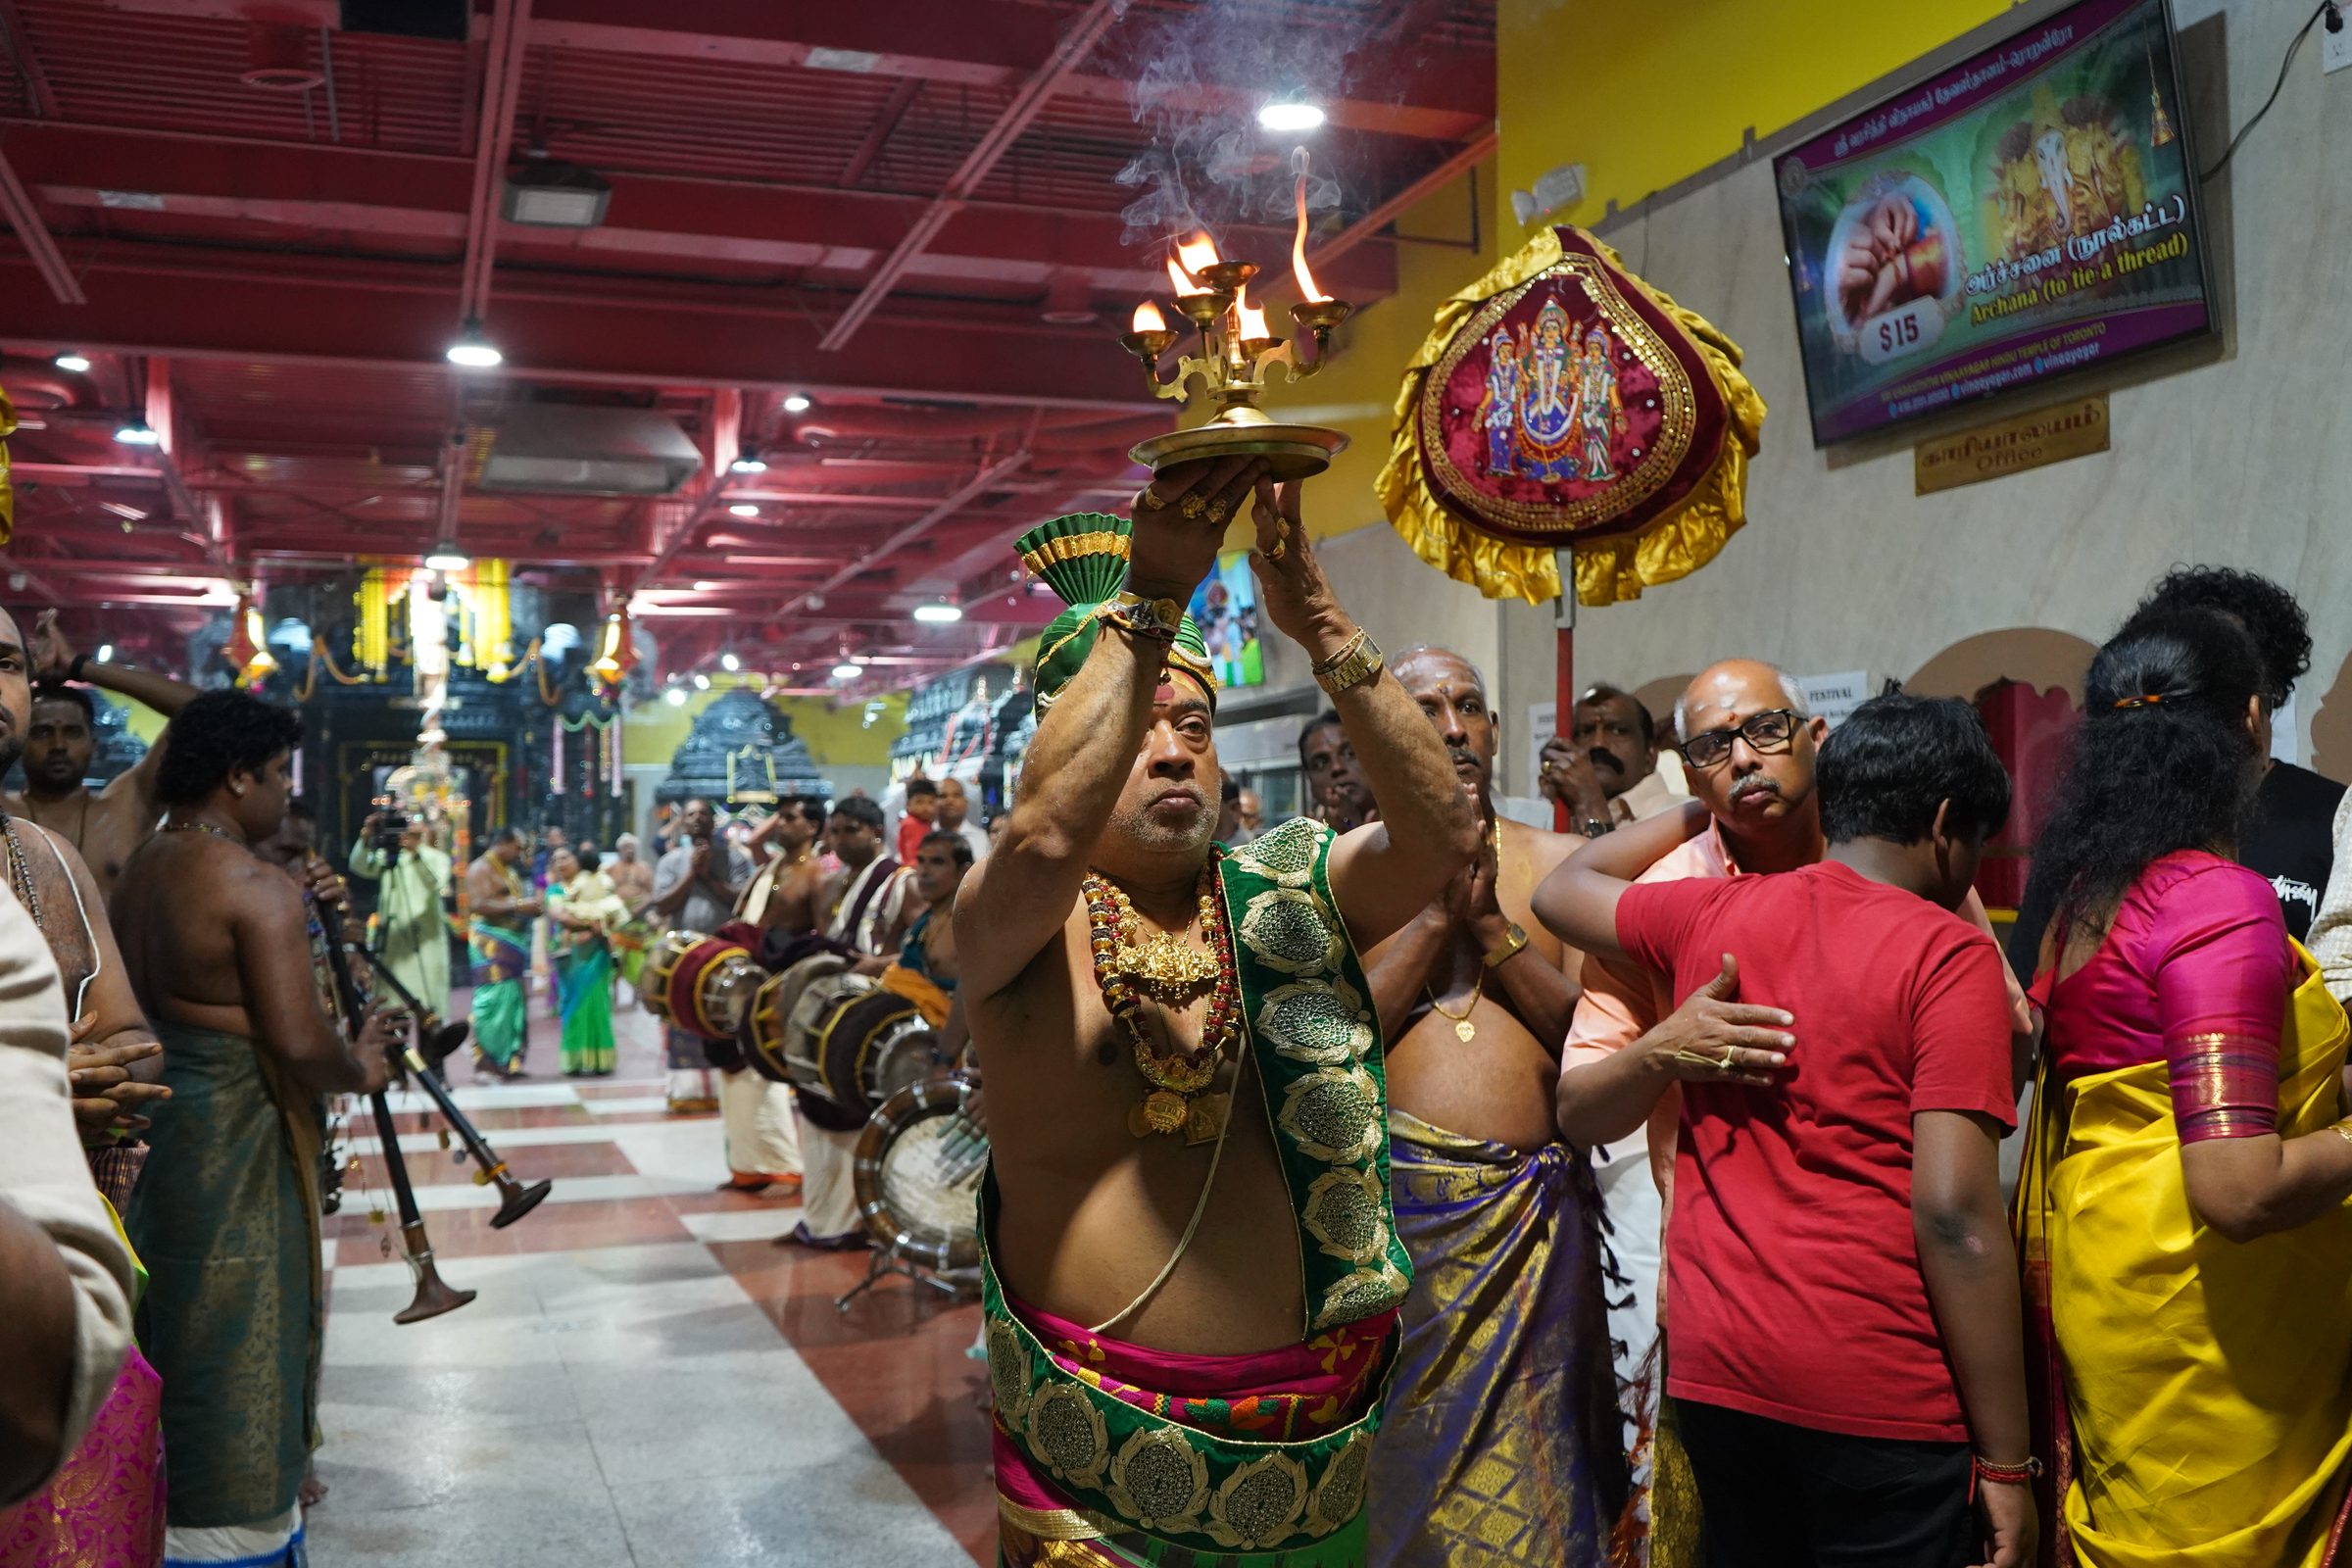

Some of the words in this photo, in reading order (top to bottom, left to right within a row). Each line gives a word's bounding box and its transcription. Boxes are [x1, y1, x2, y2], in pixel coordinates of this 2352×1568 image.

[1971, 288, 2040, 326] Archana
[2042, 276, 2068, 303] (to
[2072, 267, 2095, 288] tie
[2099, 262, 2115, 281] a
[2116, 231, 2188, 275] thread)
[1879, 314, 1920, 354] $15
[2061, 320, 2107, 346] TORONTO
[1976, 446, 2042, 472] Office
[1809, 687, 1853, 702] FESTIVAL
